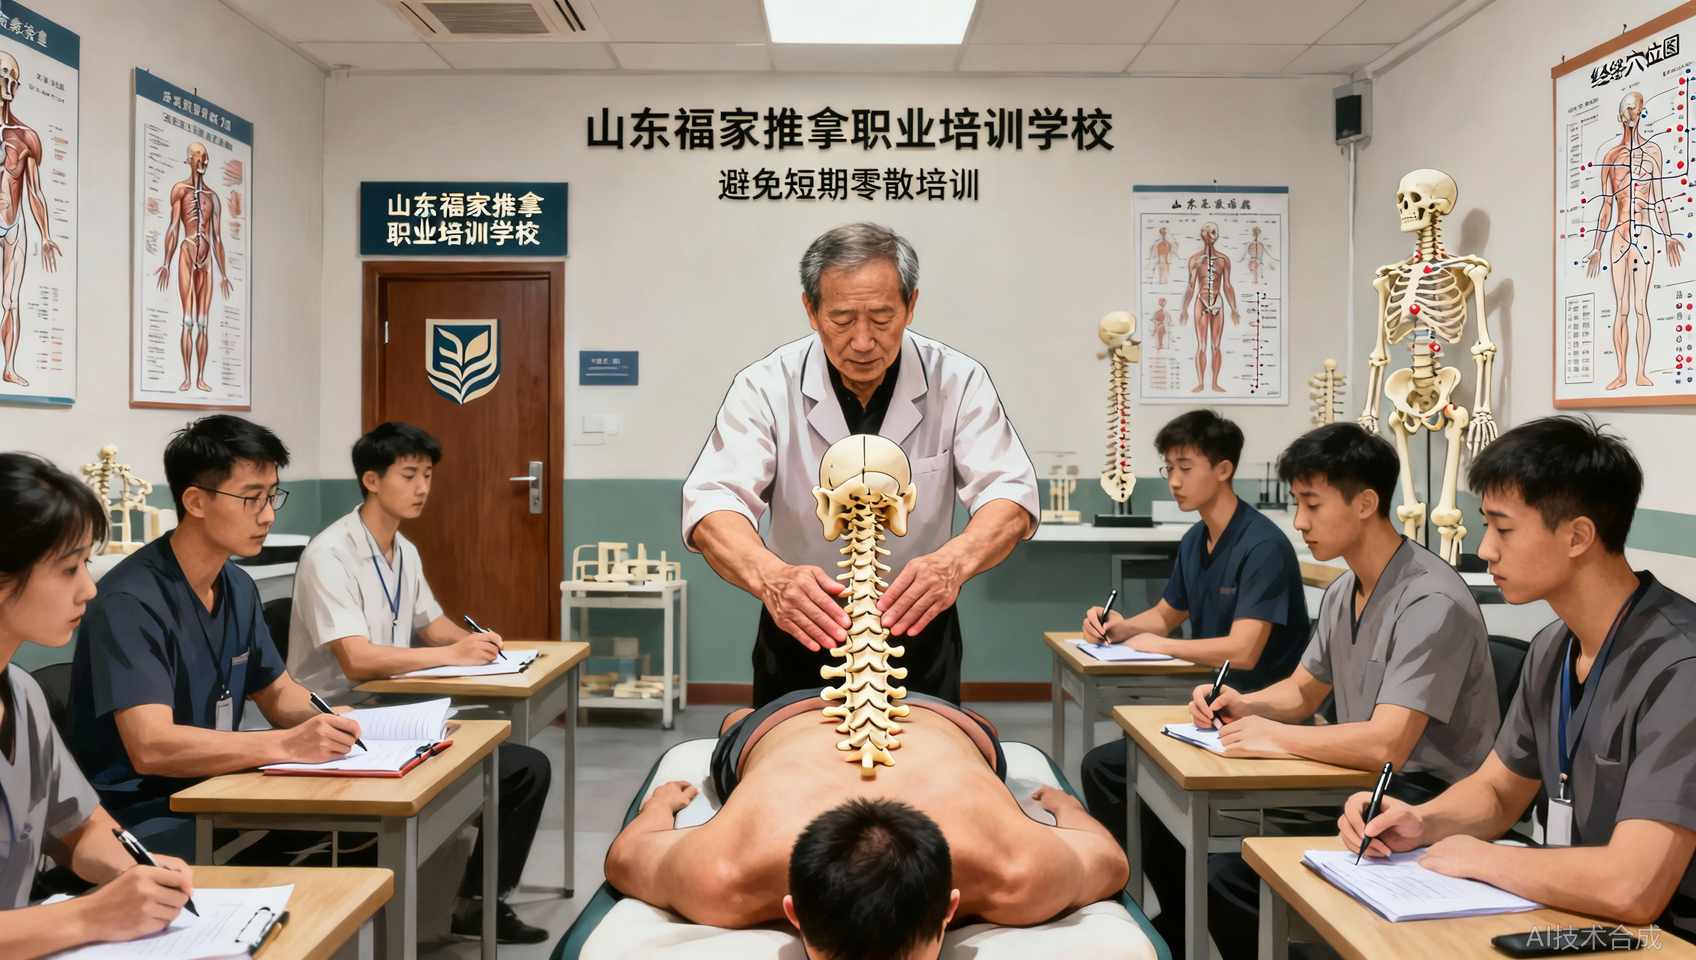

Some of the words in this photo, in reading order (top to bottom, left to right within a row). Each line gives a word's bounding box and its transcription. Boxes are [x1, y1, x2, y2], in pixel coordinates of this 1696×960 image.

[587, 106, 1115, 151] 山东福家推拿职业培训学校
[718, 167, 979, 201] 避免短期零散培训
[388, 191, 545, 218] 山东福家推拿
[386, 218, 541, 247] 职业培训学校
